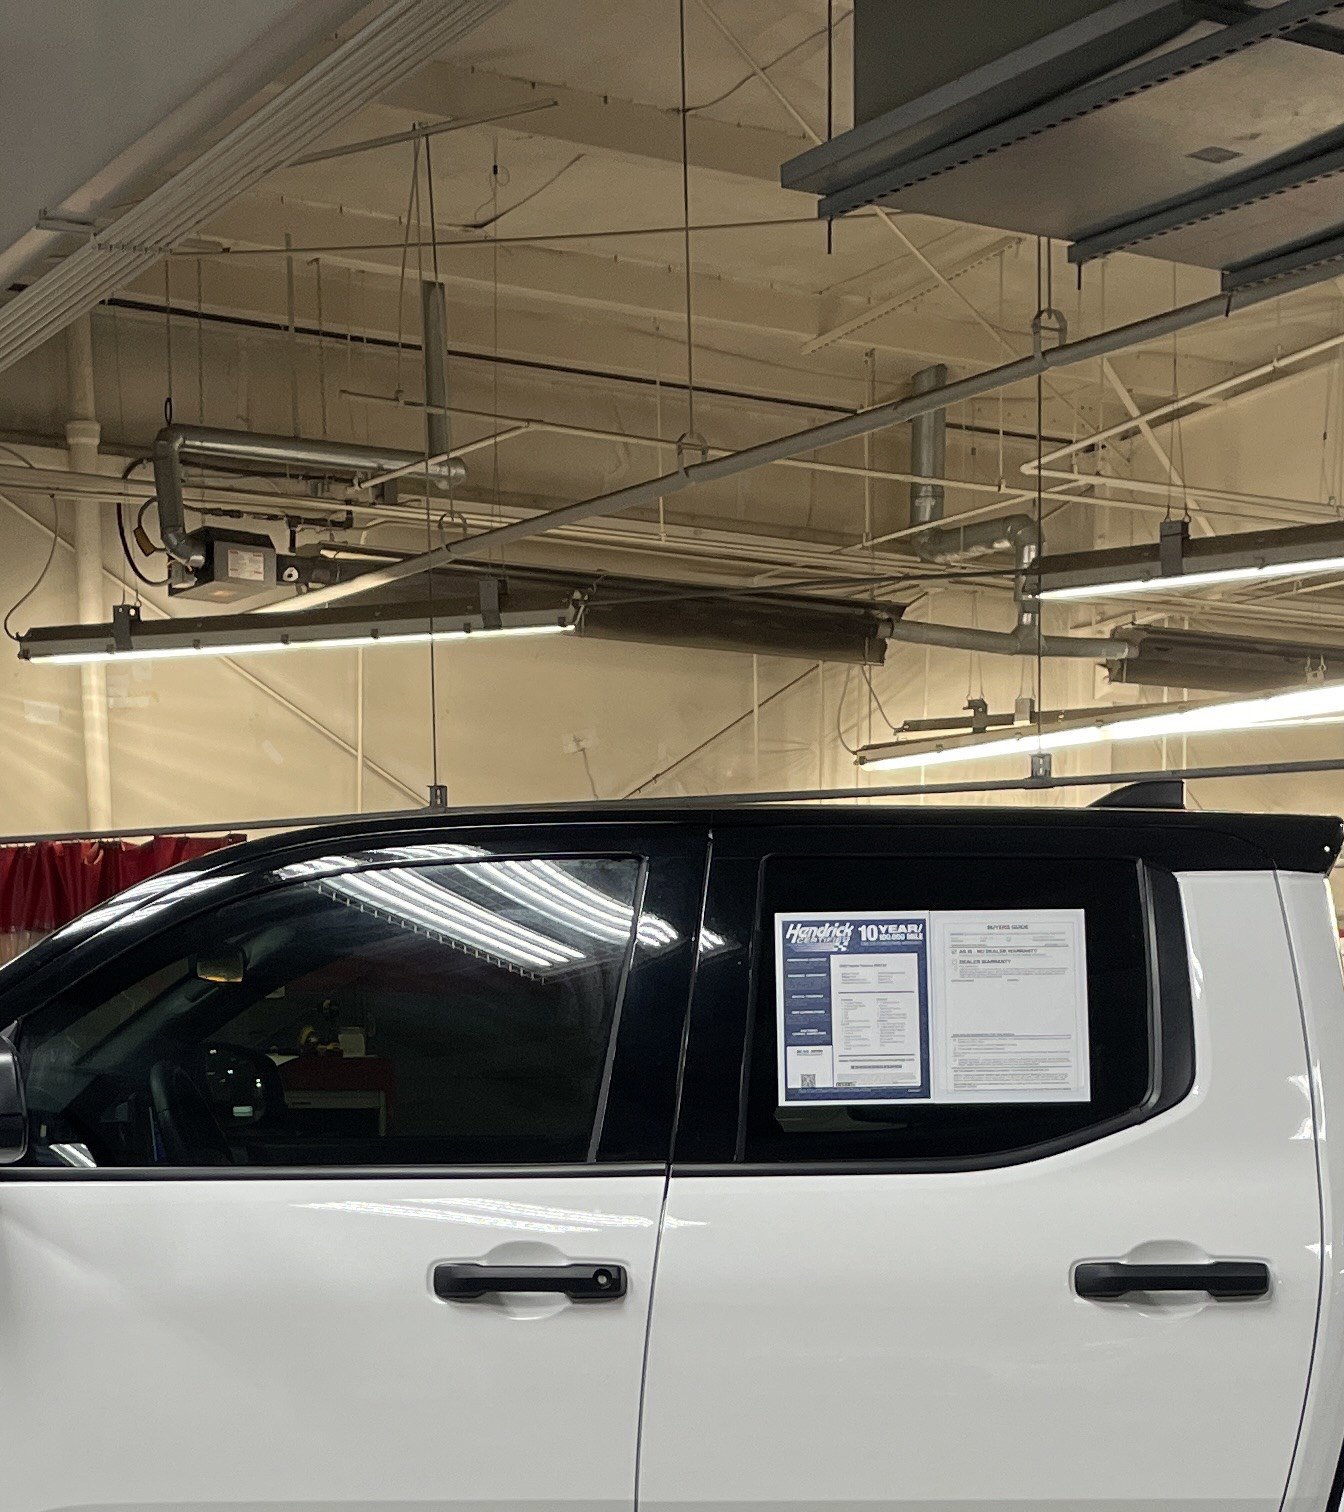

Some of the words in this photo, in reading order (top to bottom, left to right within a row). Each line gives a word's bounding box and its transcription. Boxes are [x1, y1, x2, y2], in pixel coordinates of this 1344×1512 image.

[785, 922, 855, 944] Hendrick
[858, 924, 878, 941] 10
[878, 923, 923, 934] YEAR/
